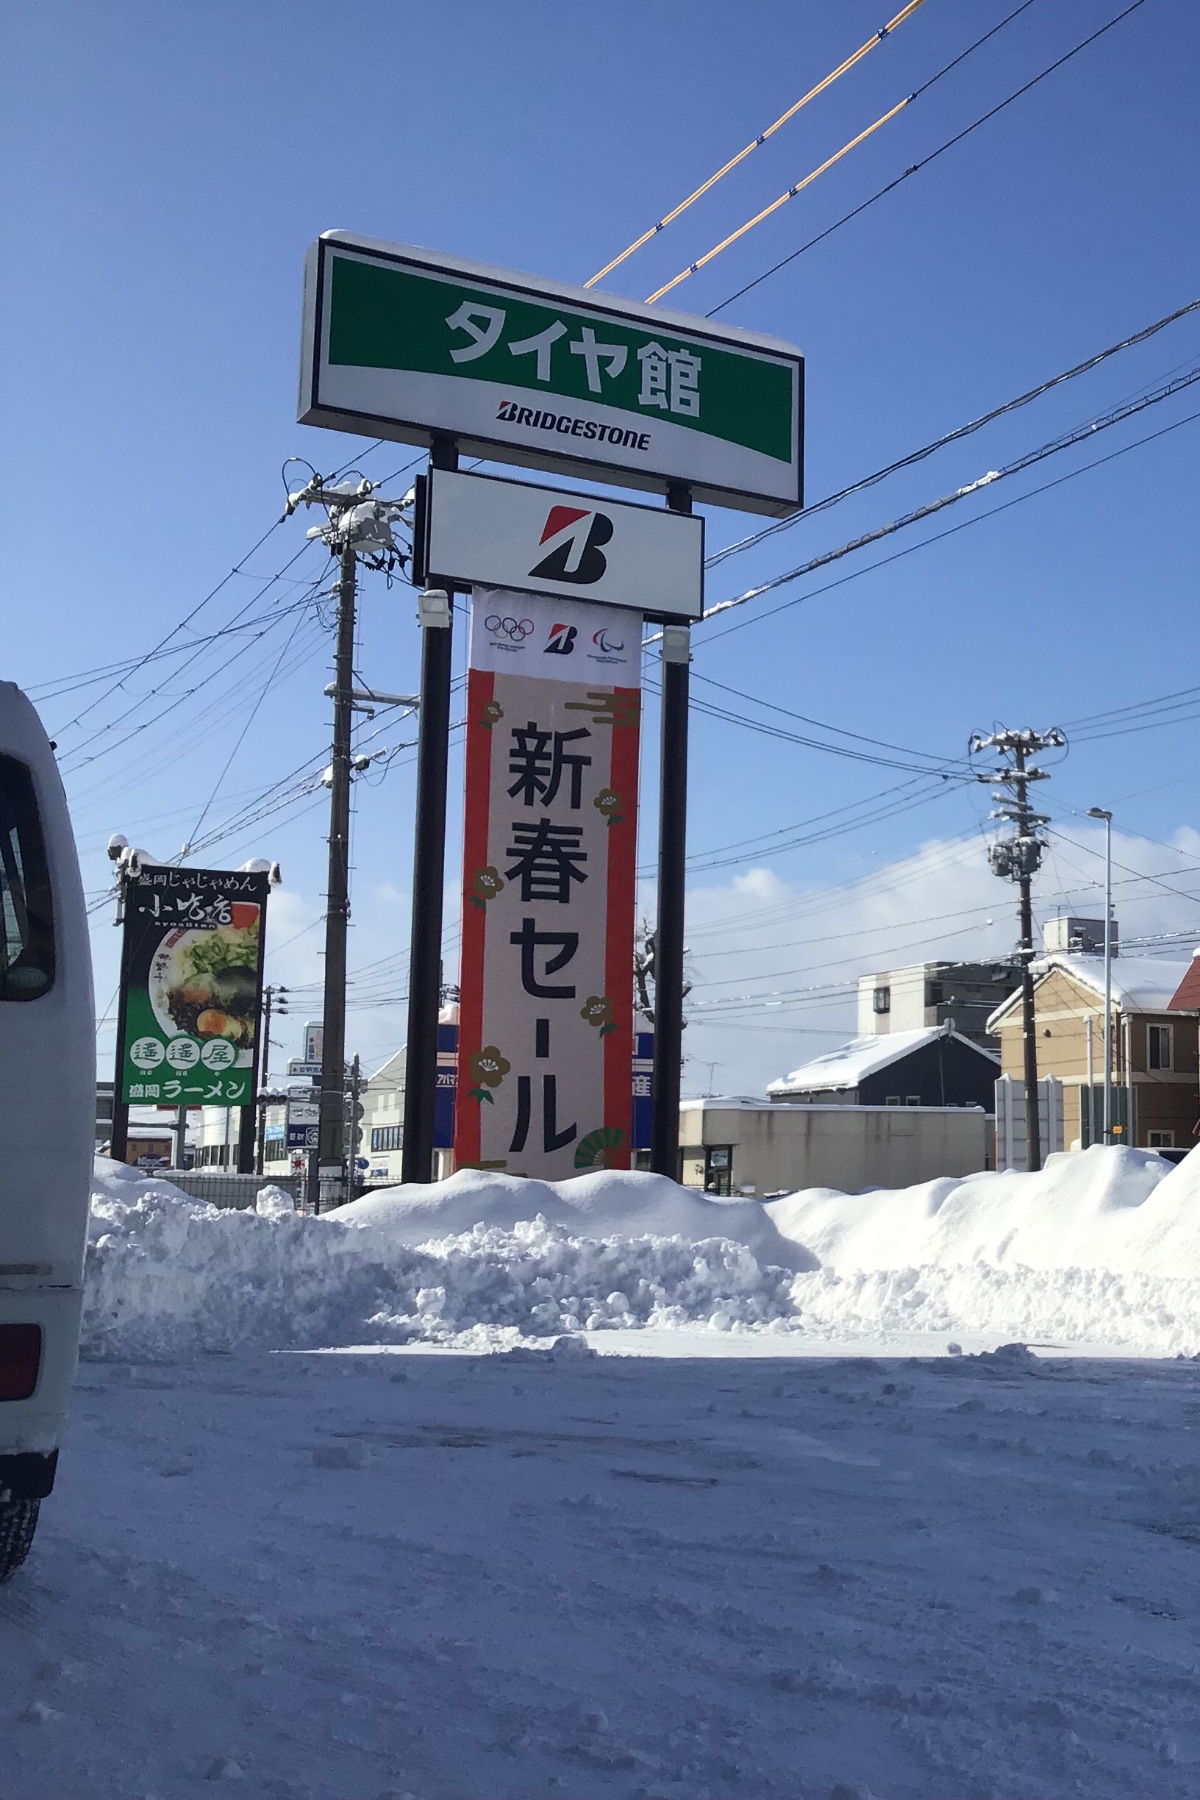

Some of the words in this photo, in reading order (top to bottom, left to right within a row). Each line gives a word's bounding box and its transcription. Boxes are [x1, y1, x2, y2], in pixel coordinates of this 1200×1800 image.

[444, 300, 703, 419] タイヤ館
[495, 399, 652, 452] BRIDGESTONE
[138, 871, 257, 892] 盛岡じゃじゃめん
[504, 721, 592, 1153] 新春セール
[129, 1079, 246, 1099] 盛岡ラーメン
